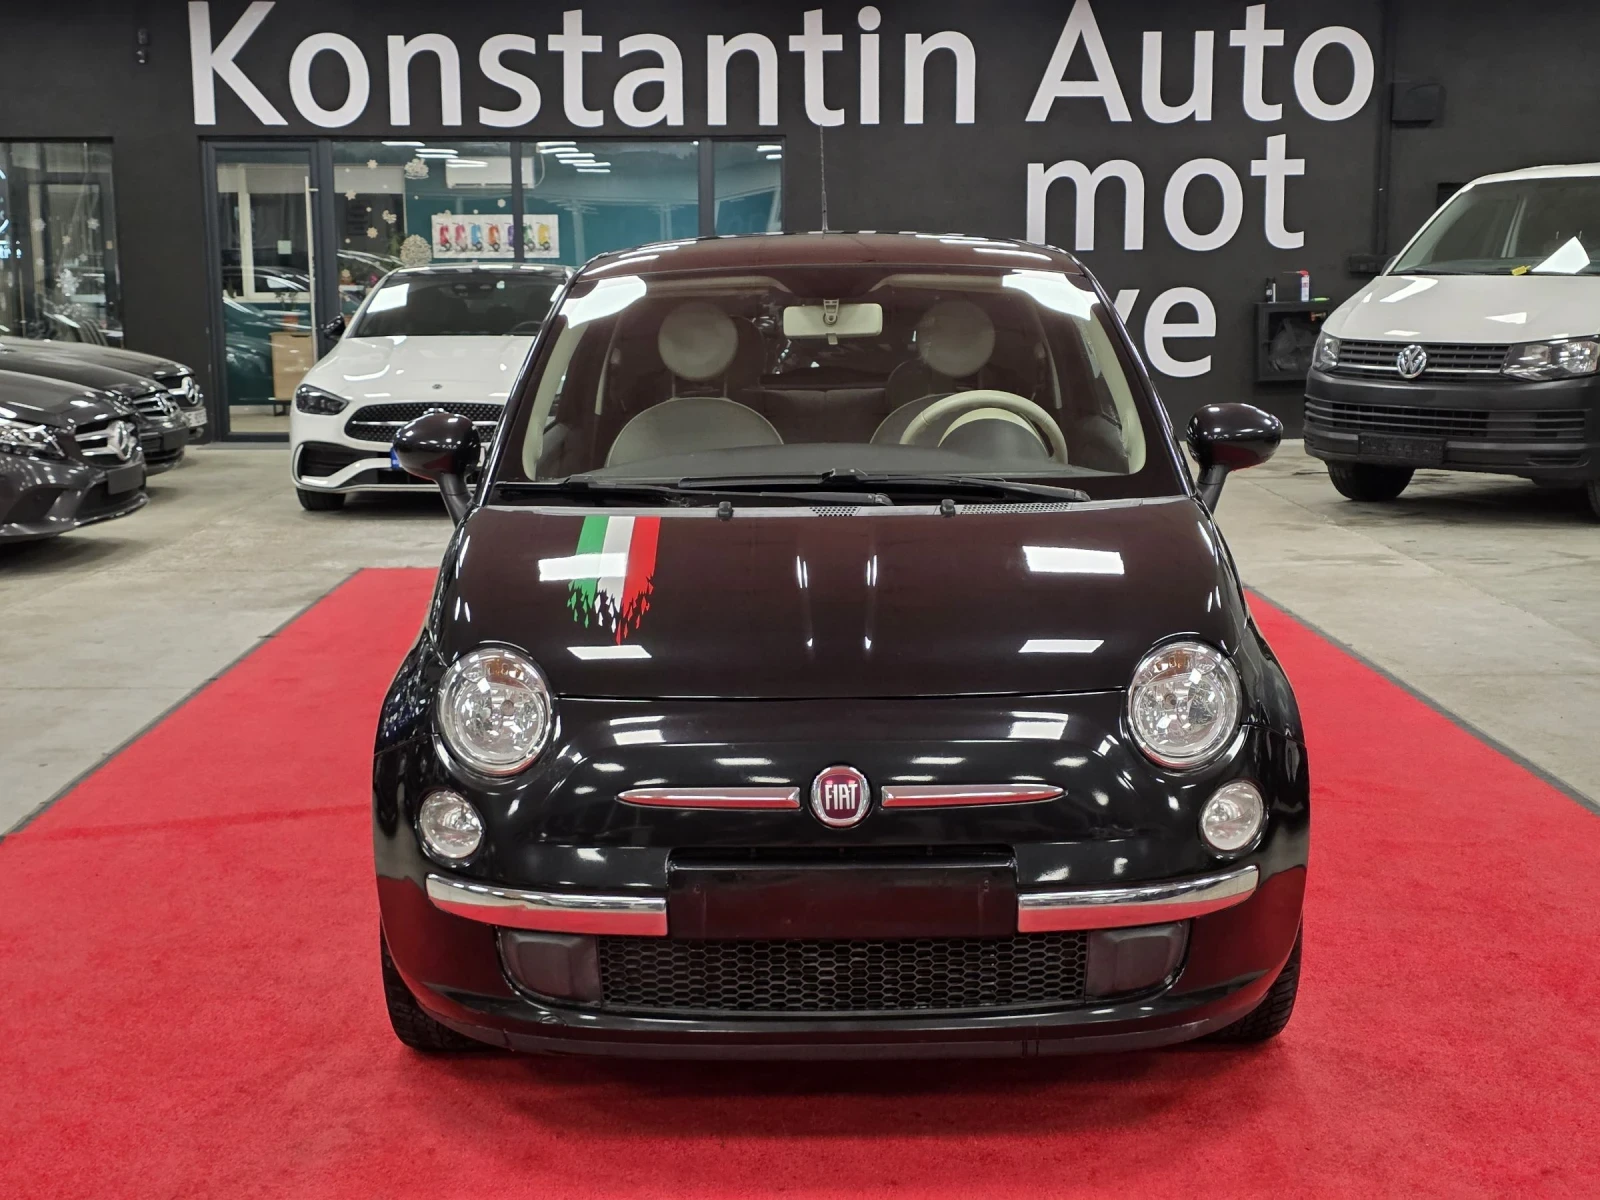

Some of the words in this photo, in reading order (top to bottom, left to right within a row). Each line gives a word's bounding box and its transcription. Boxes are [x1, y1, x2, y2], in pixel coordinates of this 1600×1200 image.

[189, 1, 976, 128] Konstantin
[1025, 0, 1375, 123] Auto
[1026, 133, 1306, 252] mot
[825, 783, 858, 810] FIAT
